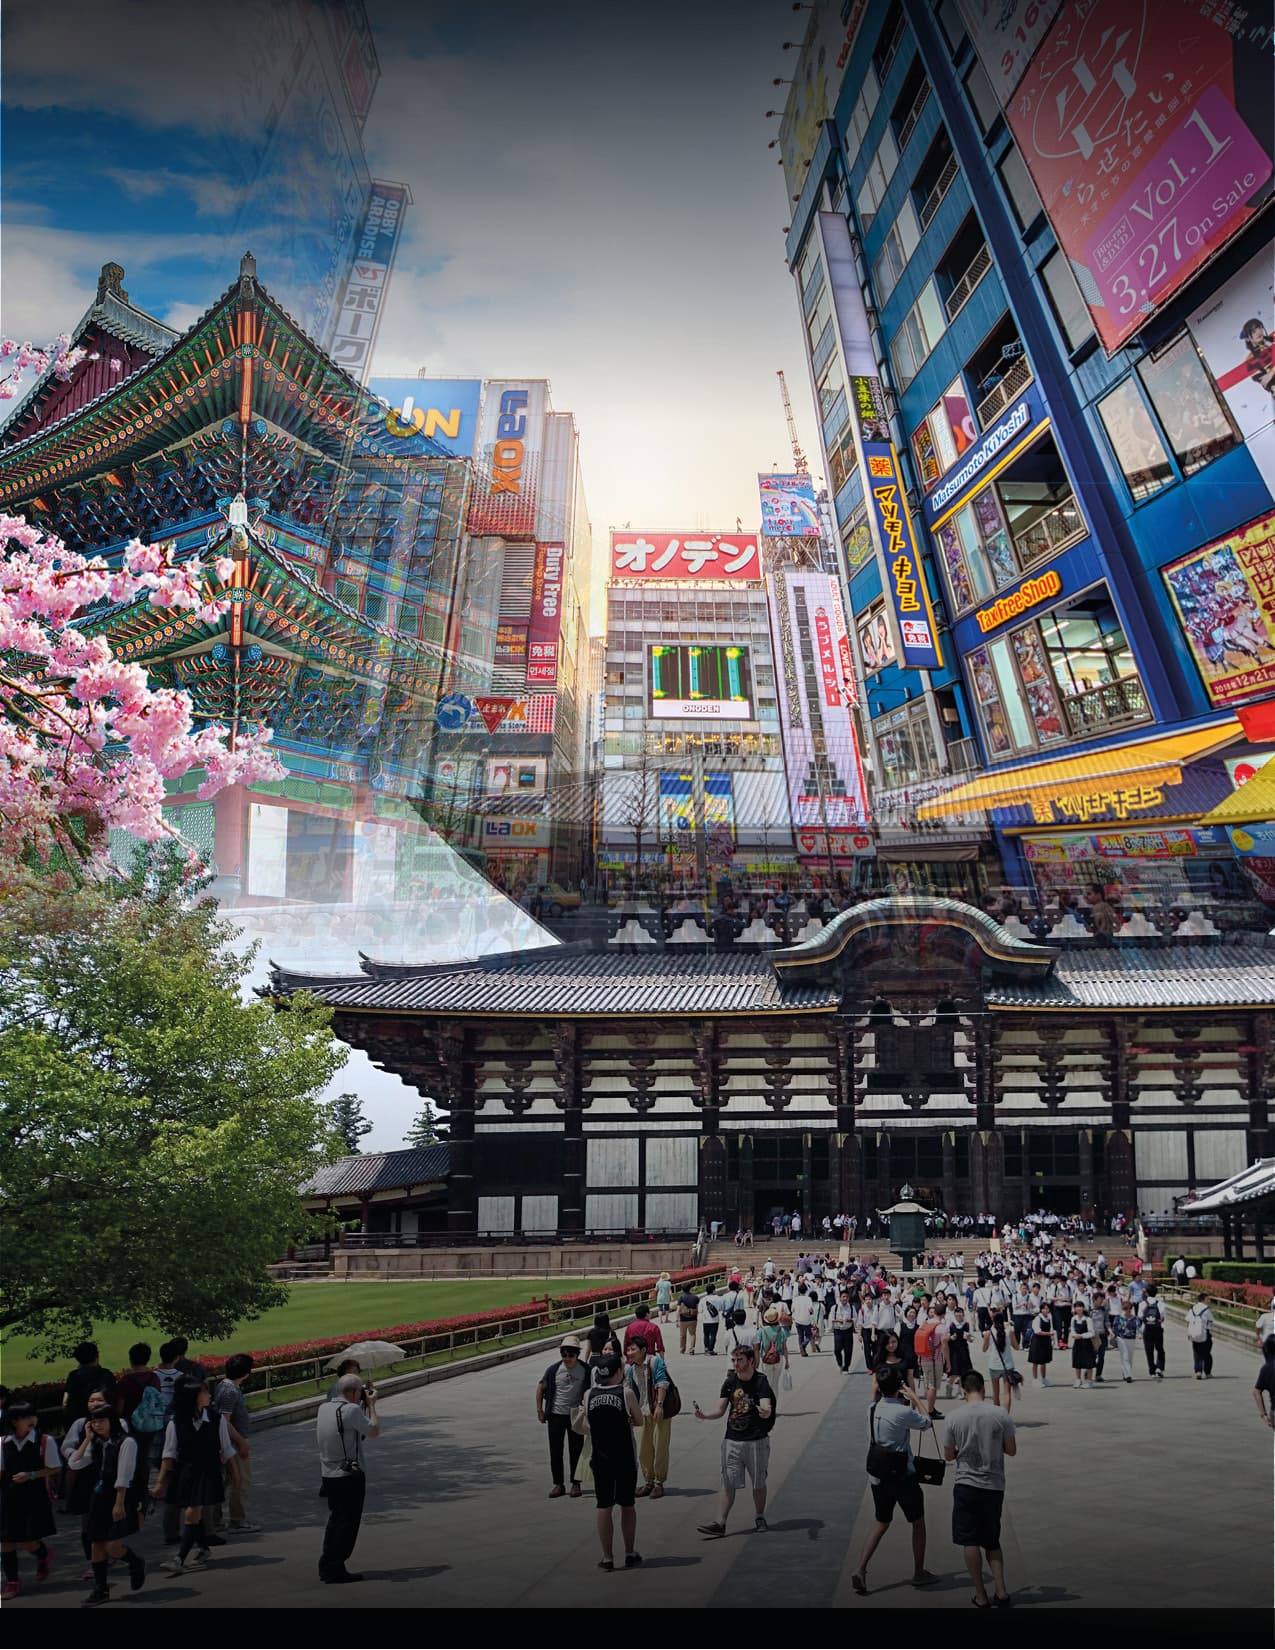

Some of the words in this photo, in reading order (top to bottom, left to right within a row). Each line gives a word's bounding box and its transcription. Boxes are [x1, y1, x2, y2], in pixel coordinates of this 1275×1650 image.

[1129, 157, 1197, 221] Vol.
[1183, 108, 1231, 164] 1
[1096, 221, 1127, 258] Blu-ray
[1112, 217, 1182, 314] 3.27
[1185, 217, 1216, 246] On
[1212, 172, 1257, 218] Sale
[869, 457, 893, 476] 薬
[933, 452, 985, 510] Matsumoto
[544, 547, 563, 580] Duty
[614, 535, 756, 574] オノデン
[874, 485, 920, 612] マツモトキヨシ
[535, 577, 544, 600] Store
[542, 583, 561, 617] Free
[976, 610, 999, 632] Tax
[996, 592, 1024, 622] Free
[1020, 572, 1060, 606] Shop
[834, 604, 845, 633] GOODS
[817, 621, 838, 703] ラブメルシー
[840, 644, 850, 667] LOVE
[482, 703, 506, 713] 止まれ
[508, 721, 527, 729] Store
[681, 703, 721, 713] ONODEN
